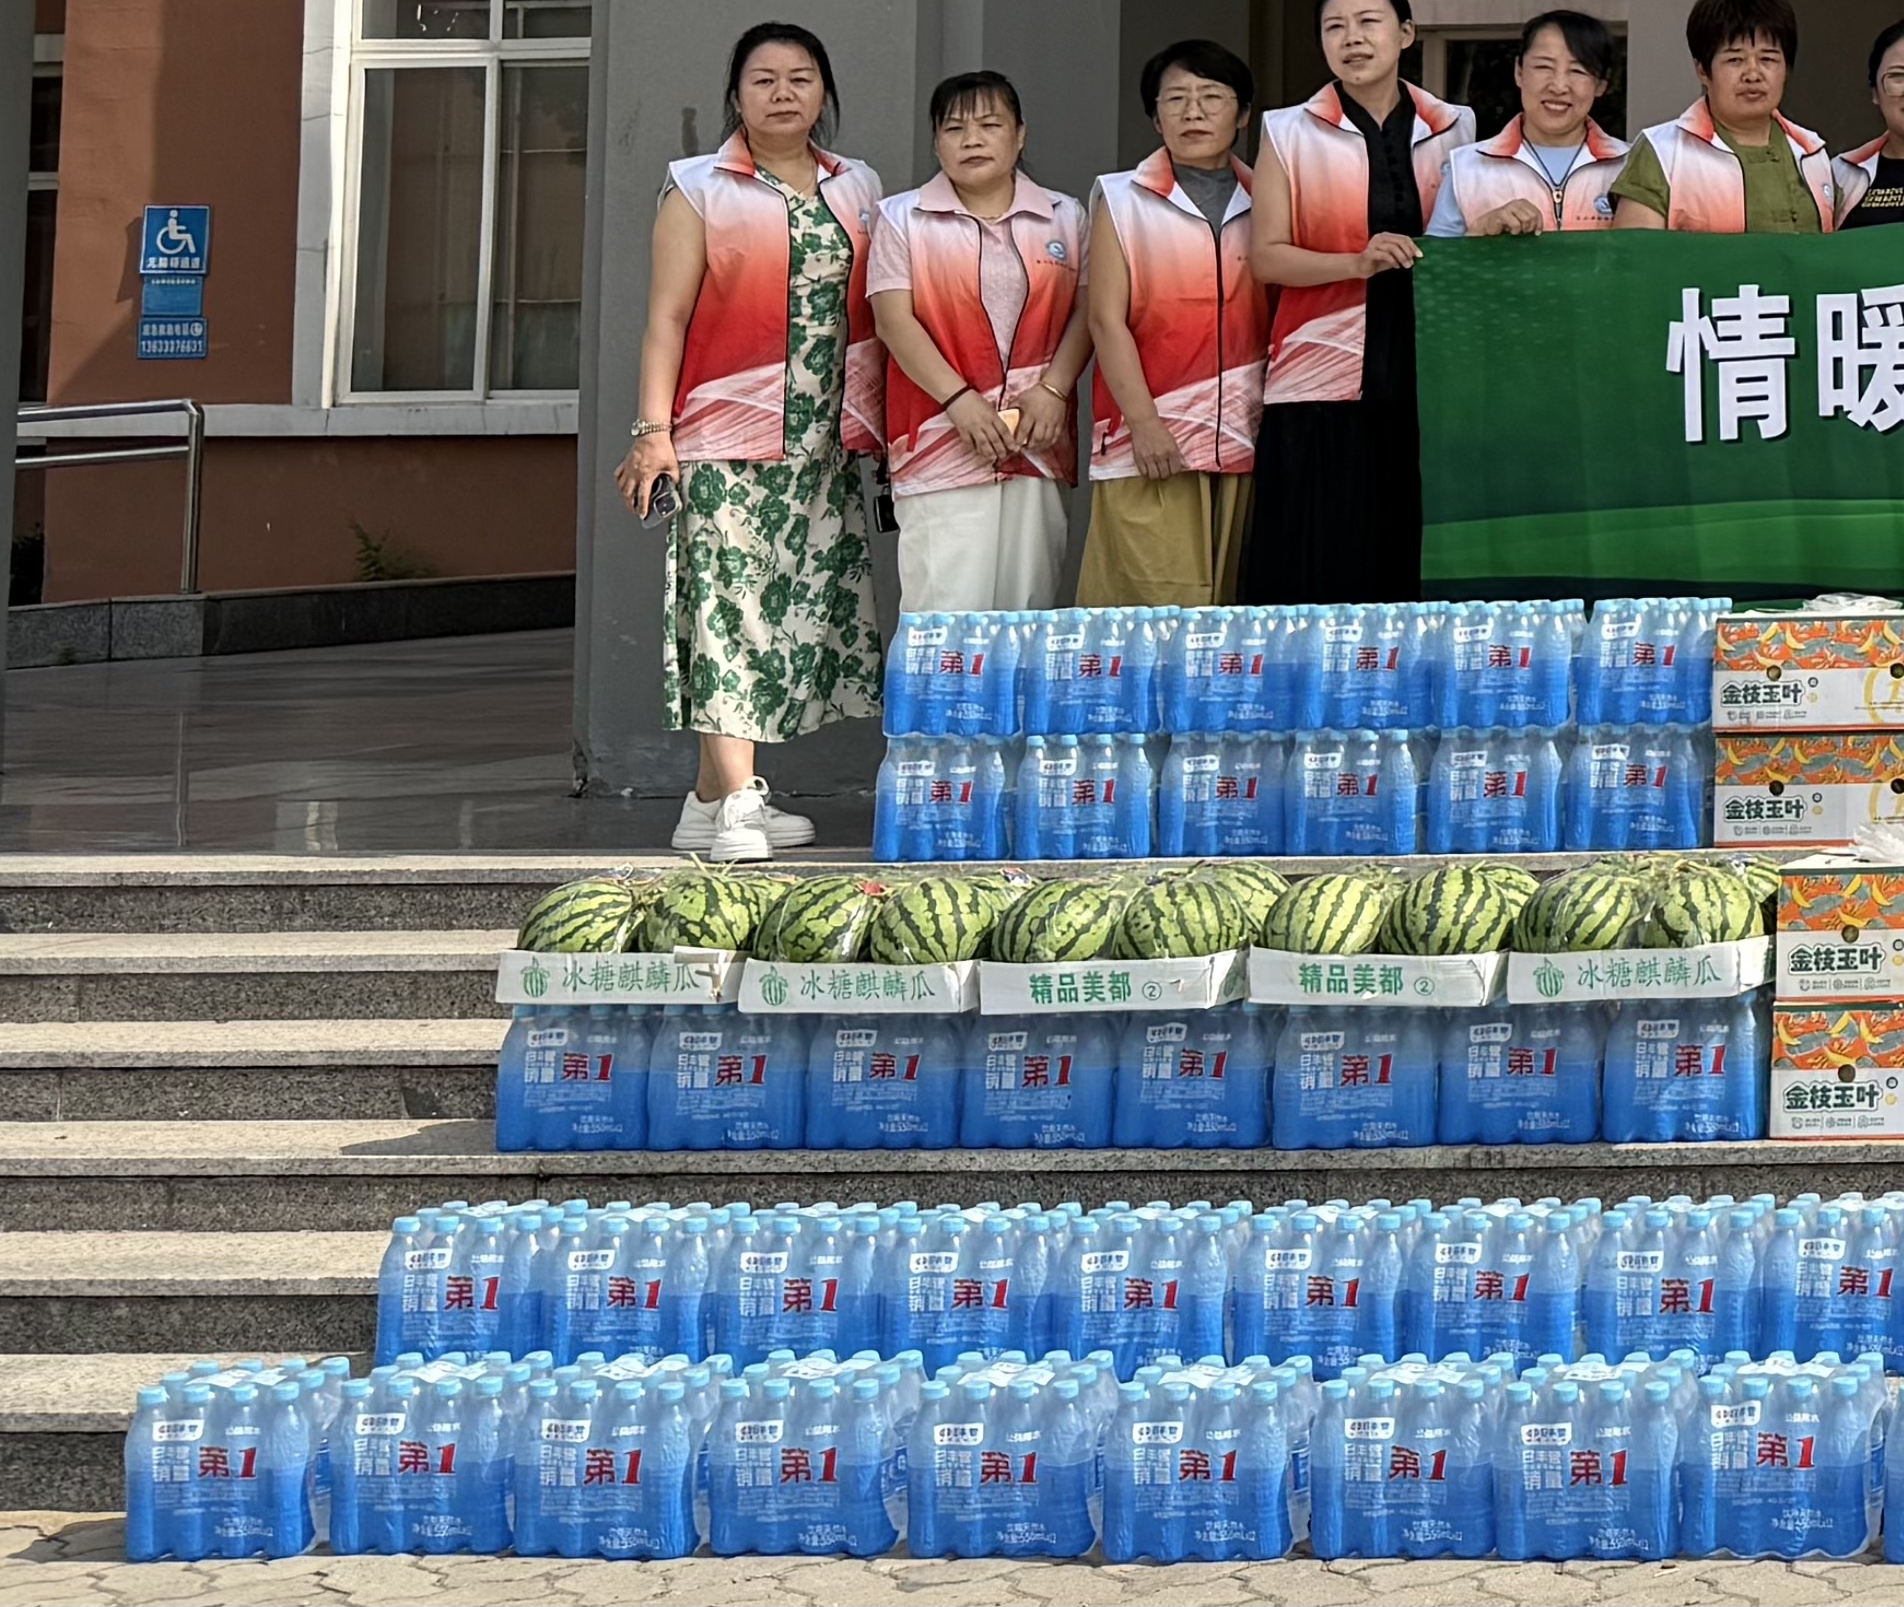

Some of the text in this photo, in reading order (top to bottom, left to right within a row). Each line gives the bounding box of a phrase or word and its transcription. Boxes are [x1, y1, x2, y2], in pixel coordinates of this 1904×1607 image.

[1722, 682, 1803, 704] 金枝玉叶
[1725, 798, 1806, 820] 金枝玉叶
[1577, 955, 1721, 990] 冰糖麒麟瓜
[1791, 945, 1882, 971] 金枝玉叶
[562, 960, 699, 993] 冰糖麒麟瓜
[800, 968, 935, 1001] 冰糖麒麟瓜
[1029, 971, 1132, 1004] 精品美都
[1299, 963, 1403, 994] 精品美都
[1787, 1082, 1878, 1108] 金枝玉叶
